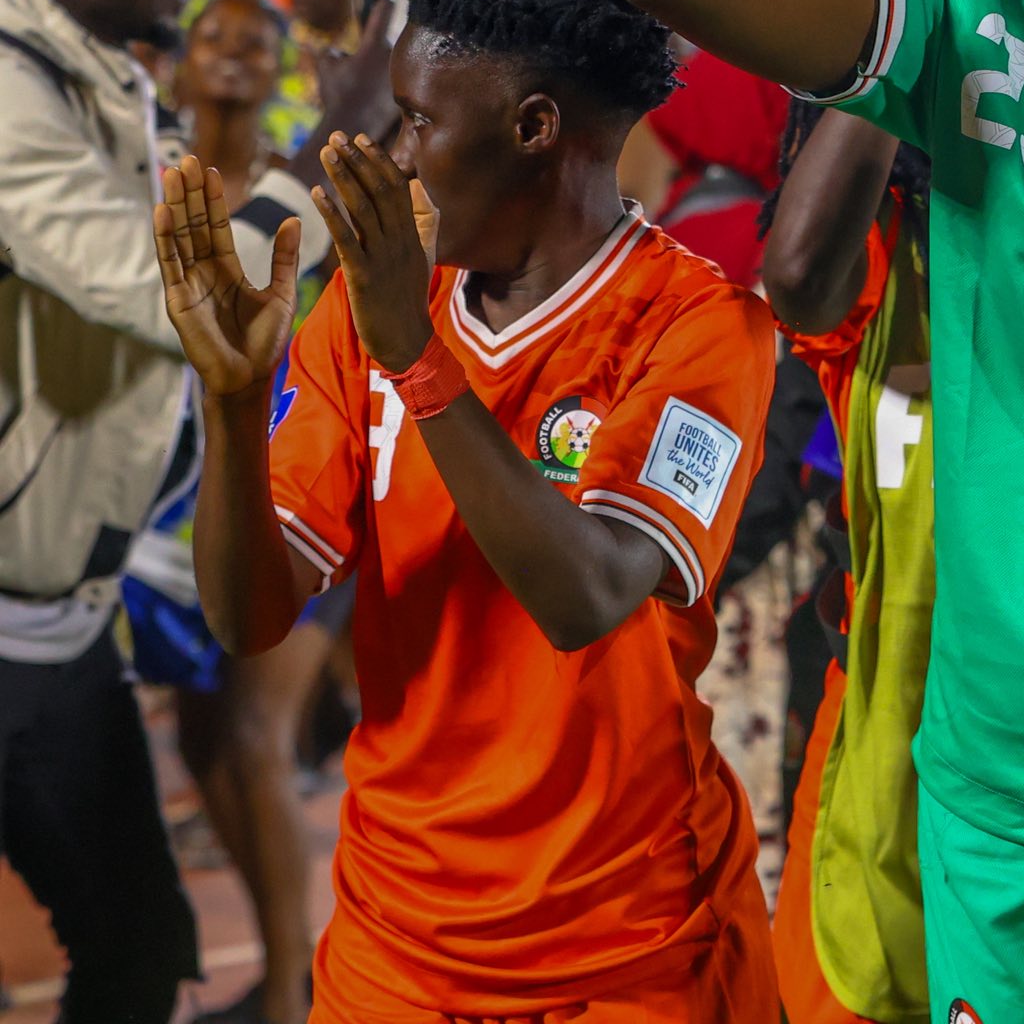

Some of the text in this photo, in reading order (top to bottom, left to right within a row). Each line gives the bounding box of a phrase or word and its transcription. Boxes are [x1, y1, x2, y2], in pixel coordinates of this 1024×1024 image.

[539, 406, 563, 461] FOOTBALL
[680, 422, 722, 458] FOOTBALL
[666, 449, 715, 490] the World
[674, 433, 719, 472] UNITES
[543, 469, 580, 483] FEDER
[677, 472, 697, 492] FIFA
